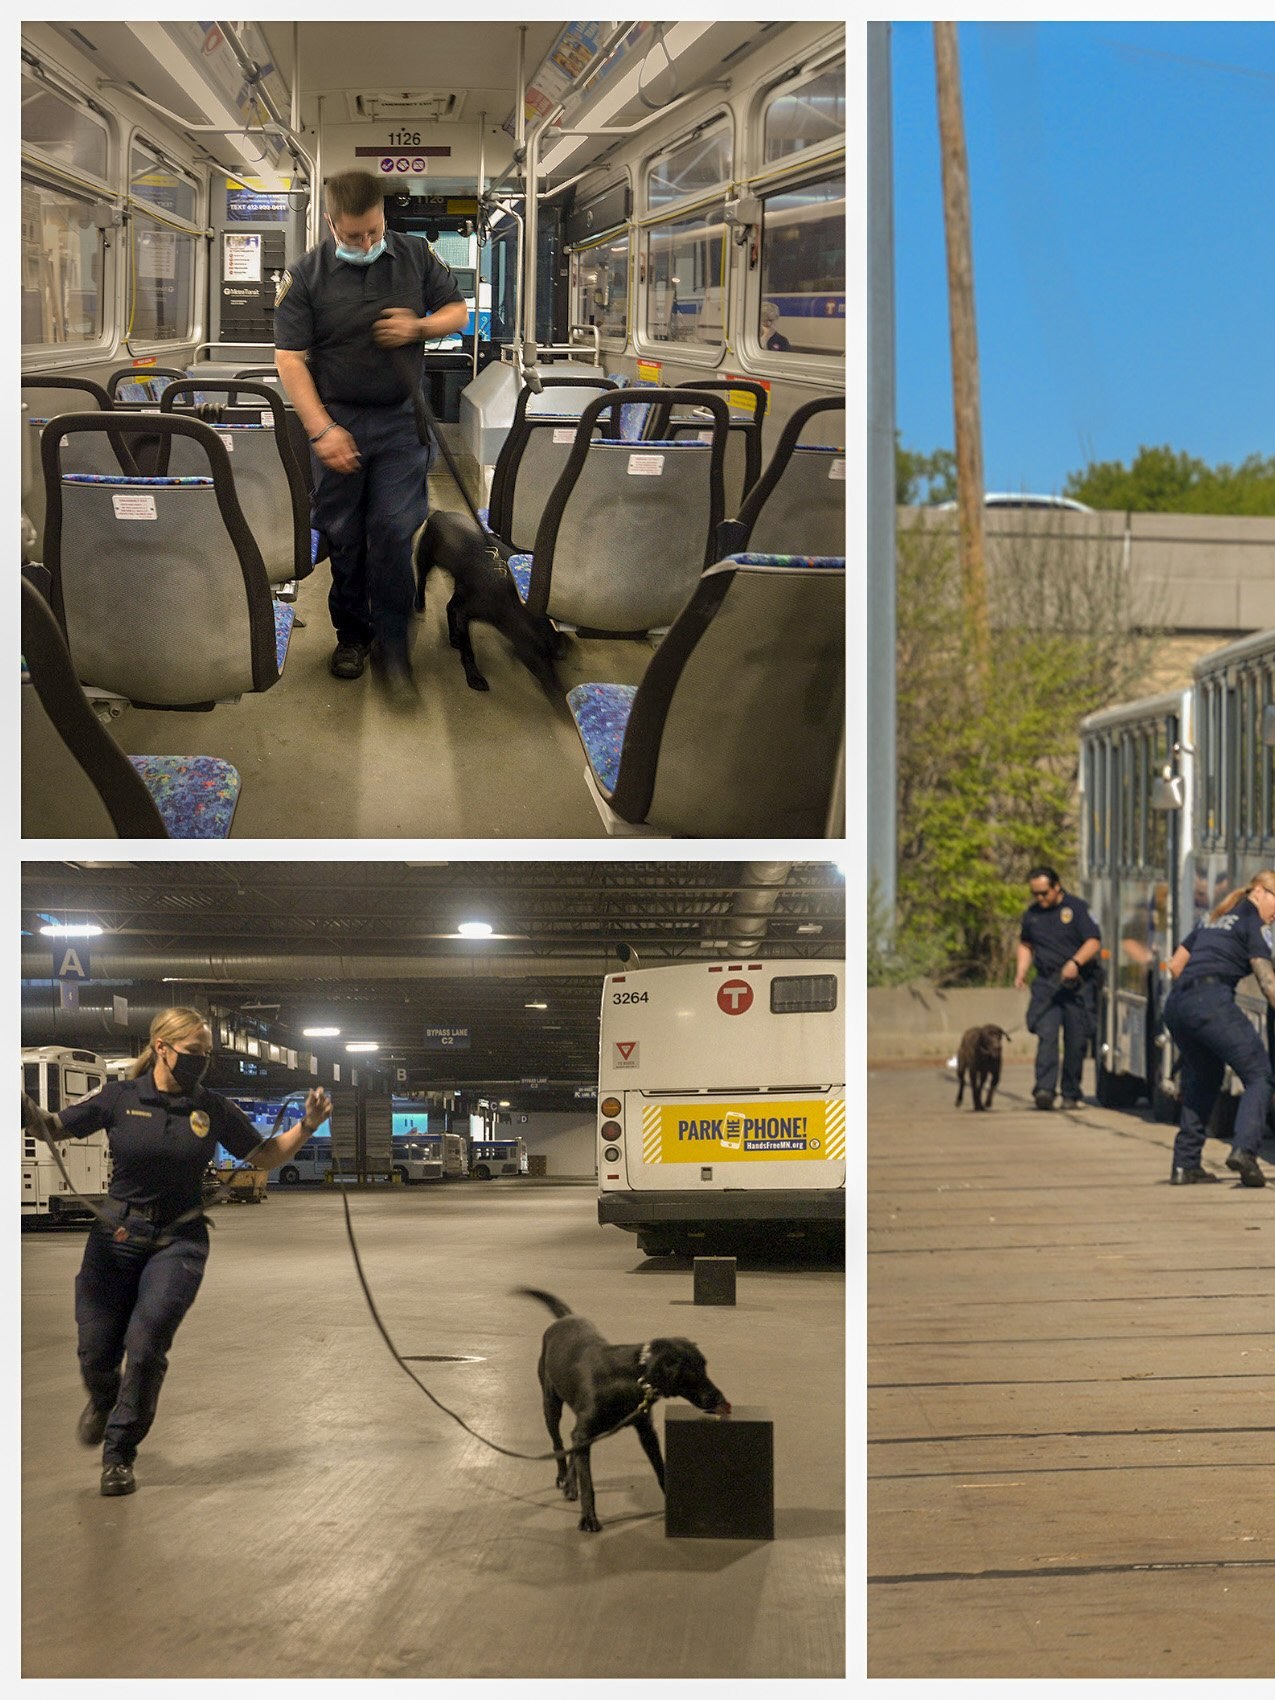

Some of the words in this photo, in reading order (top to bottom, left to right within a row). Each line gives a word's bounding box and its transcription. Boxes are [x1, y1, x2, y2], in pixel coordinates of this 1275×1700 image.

[388, 132, 421, 145] 1126
[59, 949, 86, 977] A
[612, 991, 649, 1005] 3264
[723, 987, 747, 1009] T
[426, 1029, 450, 1037] BYPASS
[451, 1029, 468, 1037] LANE
[441, 1037, 454, 1045] C2
[396, 1068, 407, 1081] B
[490, 1102, 498, 1111] C
[678, 1119, 724, 1141] PARK
[727, 1119, 740, 1138] THE
[743, 1117, 807, 1139] PHONE!
[747, 1140, 804, 1151] HandsFreeMN.org
